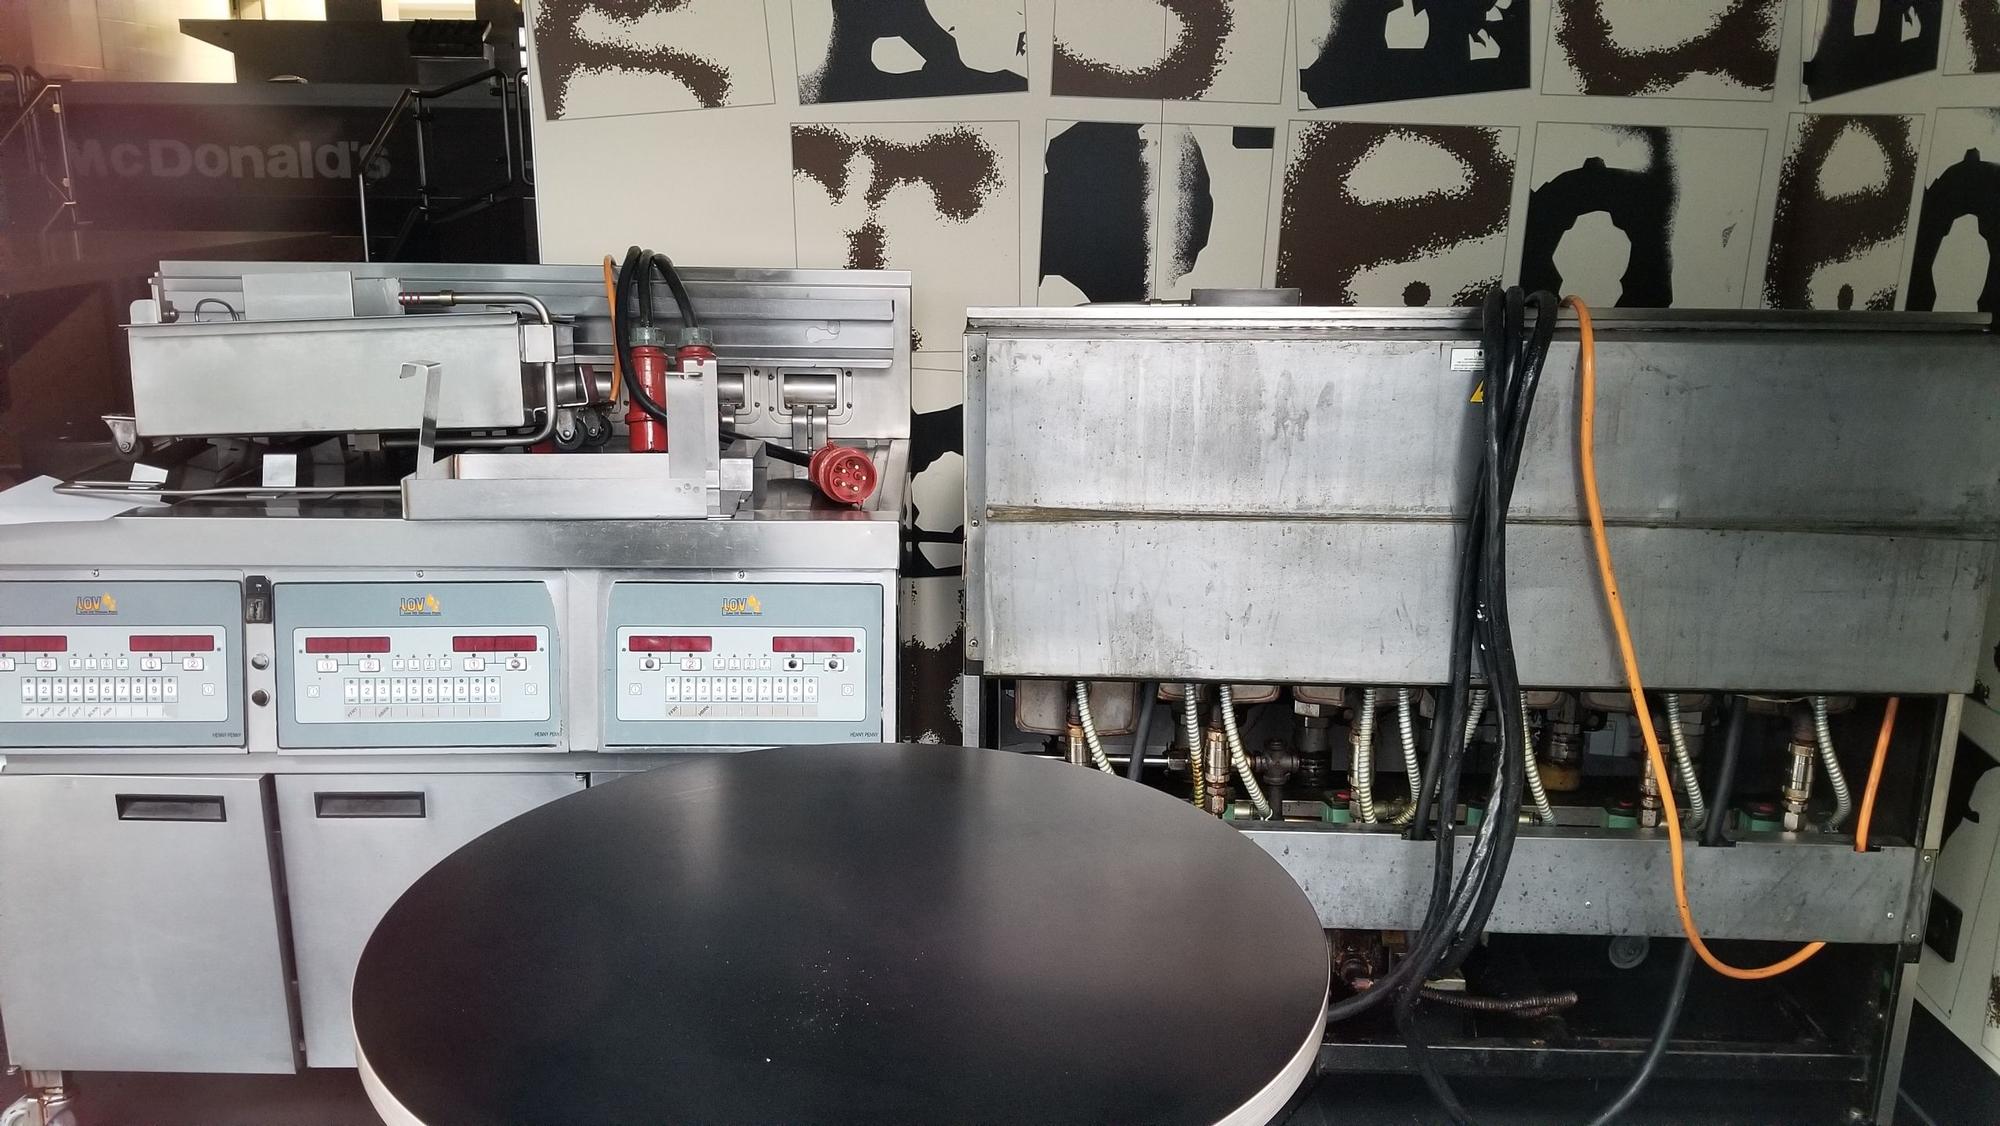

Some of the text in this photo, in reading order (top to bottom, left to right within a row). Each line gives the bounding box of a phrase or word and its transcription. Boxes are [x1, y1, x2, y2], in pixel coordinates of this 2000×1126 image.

[65, 138, 391, 179] McDonald's
[76, 596, 102, 611] LOV
[400, 597, 425, 611] LOV
[722, 597, 747, 611] LOV
